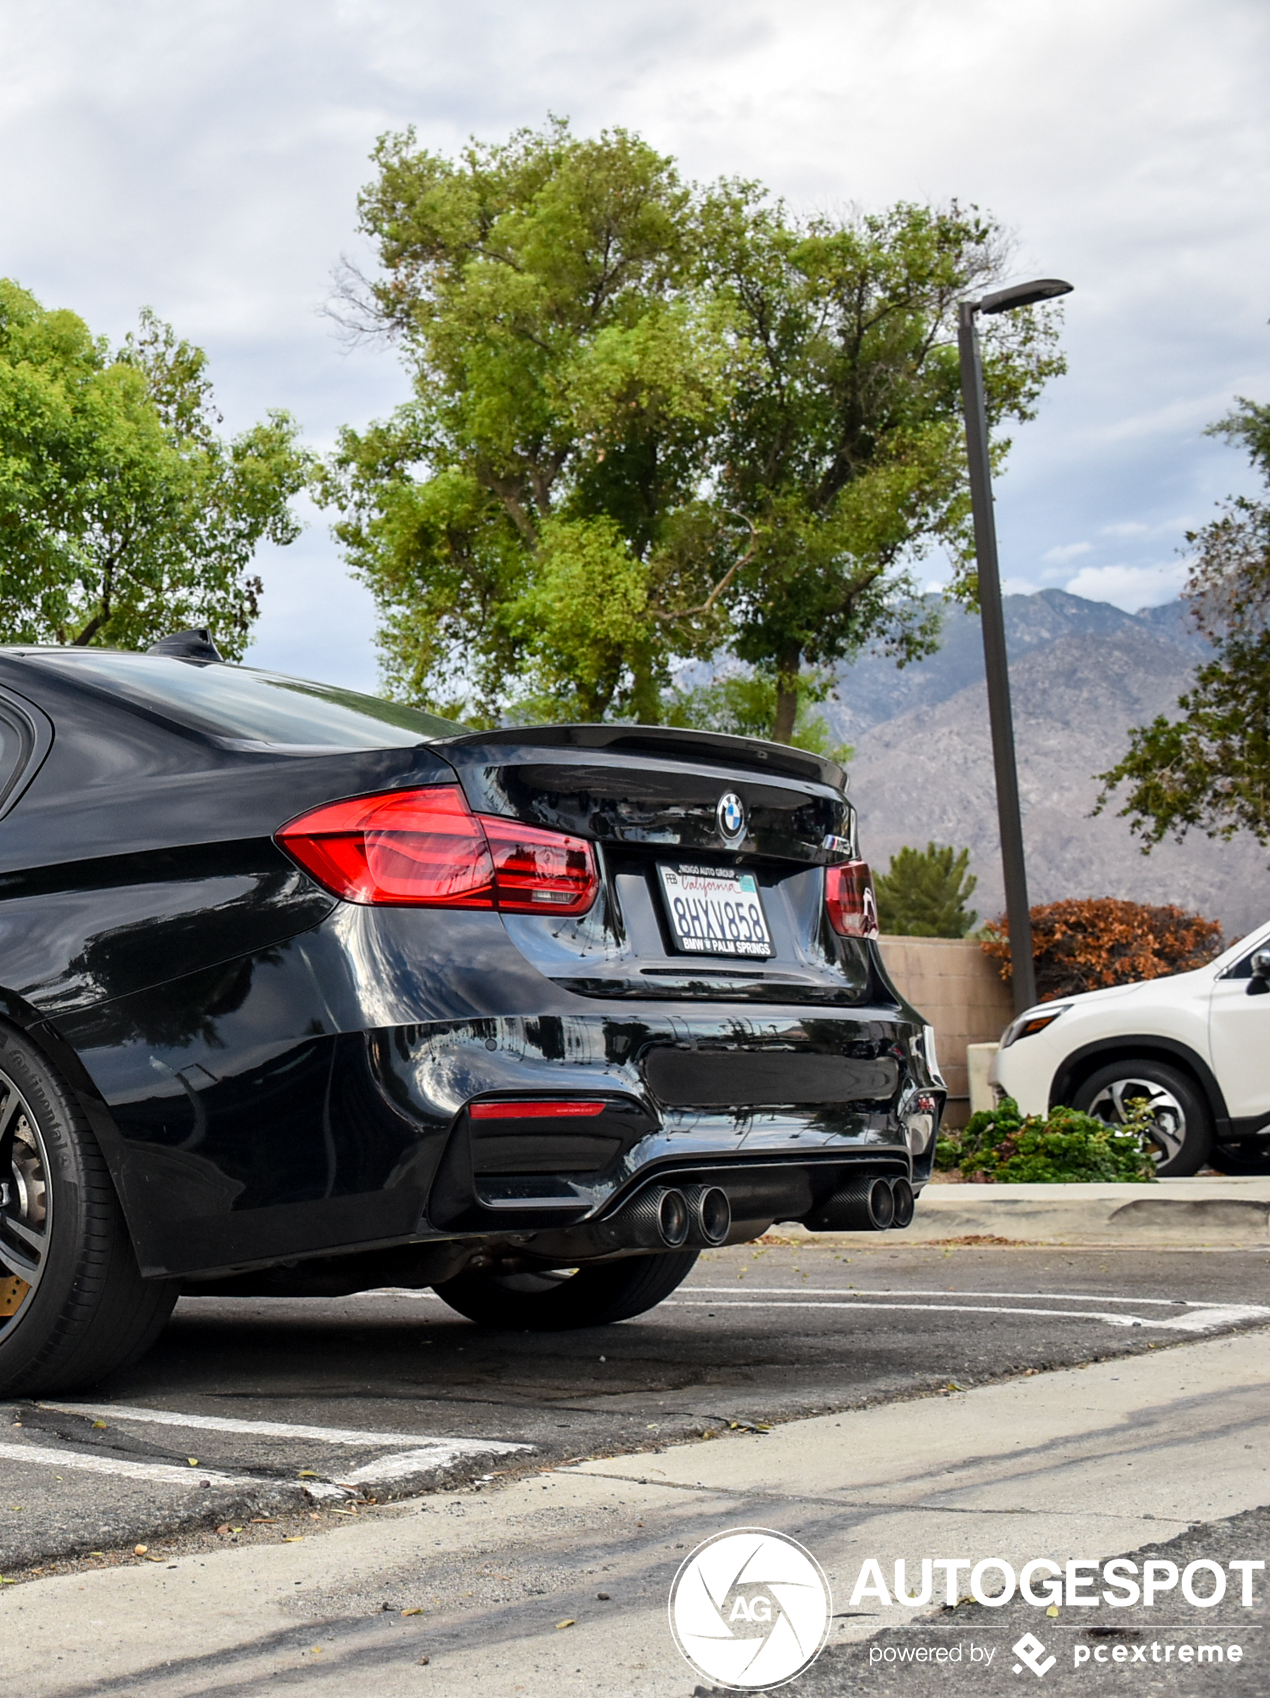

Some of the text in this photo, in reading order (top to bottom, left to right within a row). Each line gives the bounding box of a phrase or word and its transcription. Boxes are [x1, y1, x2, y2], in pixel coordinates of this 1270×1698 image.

[665, 873, 678, 885] FEB
[700, 867, 715, 876] AUTO
[715, 868, 735, 879] GROUP
[681, 874, 742, 897] California
[673, 897, 765, 942] 8HXV858
[683, 938, 770, 955] BMW PALM SPRINGS
[8, 1048, 68, 1150] Continental
